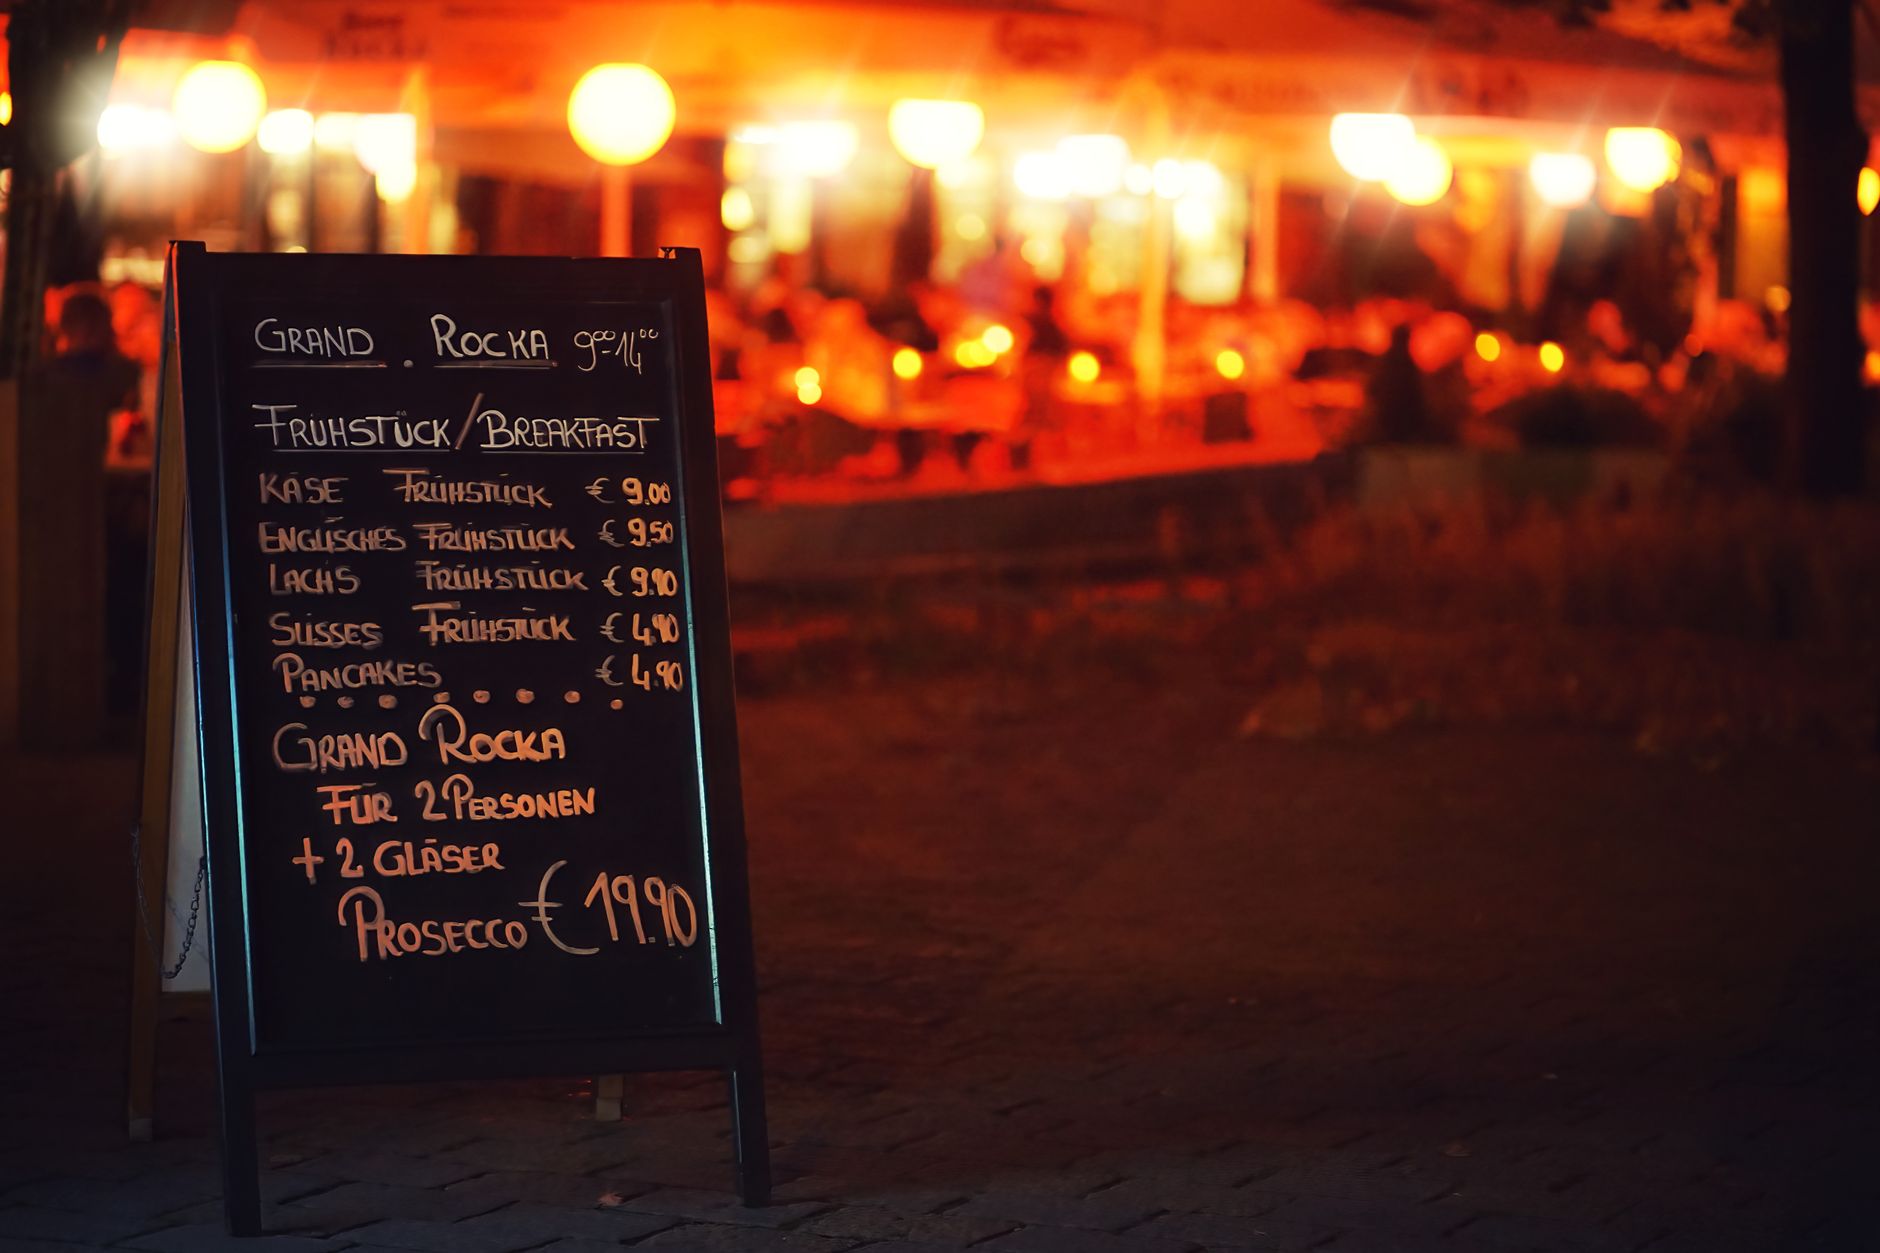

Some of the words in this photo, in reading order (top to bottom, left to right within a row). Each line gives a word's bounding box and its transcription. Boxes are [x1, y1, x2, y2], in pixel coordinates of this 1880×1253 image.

[254, 317, 375, 357] GRAND
[429, 313, 549, 359] ROCKA
[258, 471, 349, 504] KÄSE
[382, 467, 553, 508] FRÜHSTÜCK
[621, 475, 671, 506] 9.00
[258, 516, 407, 554] ENGLISCHES
[412, 520, 575, 551] FRÜHSTÜCK
[626, 516, 674, 547] 9.50
[268, 561, 361, 596] LACHS
[415, 560, 589, 592] FRÜHSTÜCK
[268, 612, 384, 649] SÜSSES
[411, 600, 577, 646] FRÜHSTÜCK
[271, 652, 443, 693] PANCAKES
[630, 652, 684, 692] 4.90
[272, 722, 408, 774] GRAND
[417, 704, 567, 765] ROCKA
[316, 781, 398, 825] FÜR
[335, 837, 364, 878] 2
[372, 838, 505, 877] GLÄSER
[337, 885, 528, 963] PROSECCO
